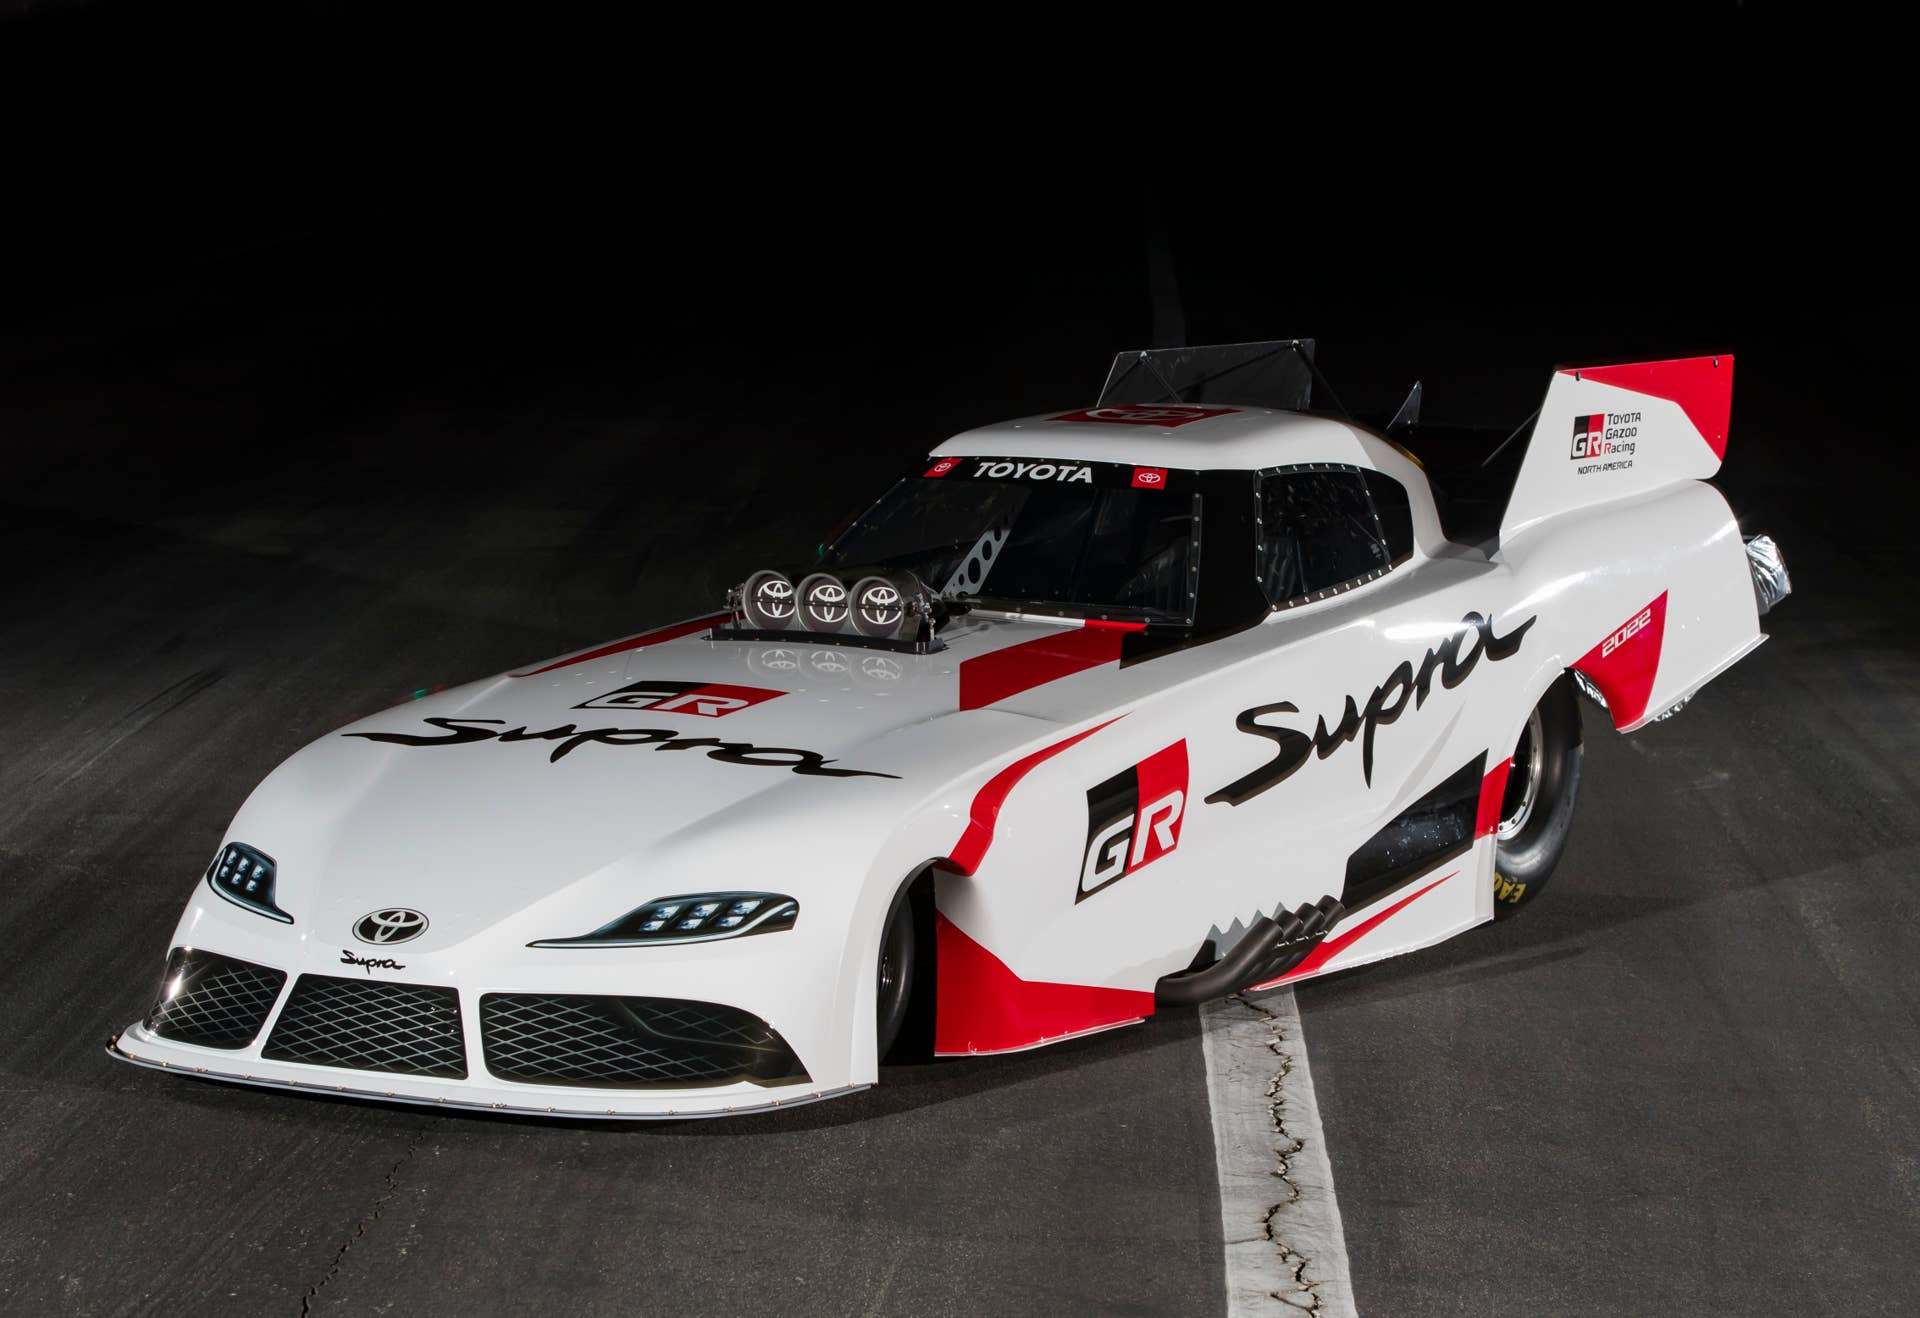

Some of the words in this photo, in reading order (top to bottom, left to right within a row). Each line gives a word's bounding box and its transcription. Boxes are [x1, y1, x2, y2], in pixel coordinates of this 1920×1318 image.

[1607, 412, 1642, 426] TOYOTA
[1571, 431, 1602, 459] GR
[1605, 427, 1638, 441] GAZOO
[1603, 441, 1636, 456] Racing
[973, 461, 1093, 485] TOYOTA
[1577, 462, 1602, 476] NORTH
[1602, 460, 1633, 473] AMERICA
[1601, 607, 1652, 659] 2022
[584, 691, 750, 717] GR
[1204, 611, 1538, 807] Supra
[341, 717, 903, 780] Supra
[1081, 789, 1184, 893] GR
[340, 949, 407, 976] Supra
